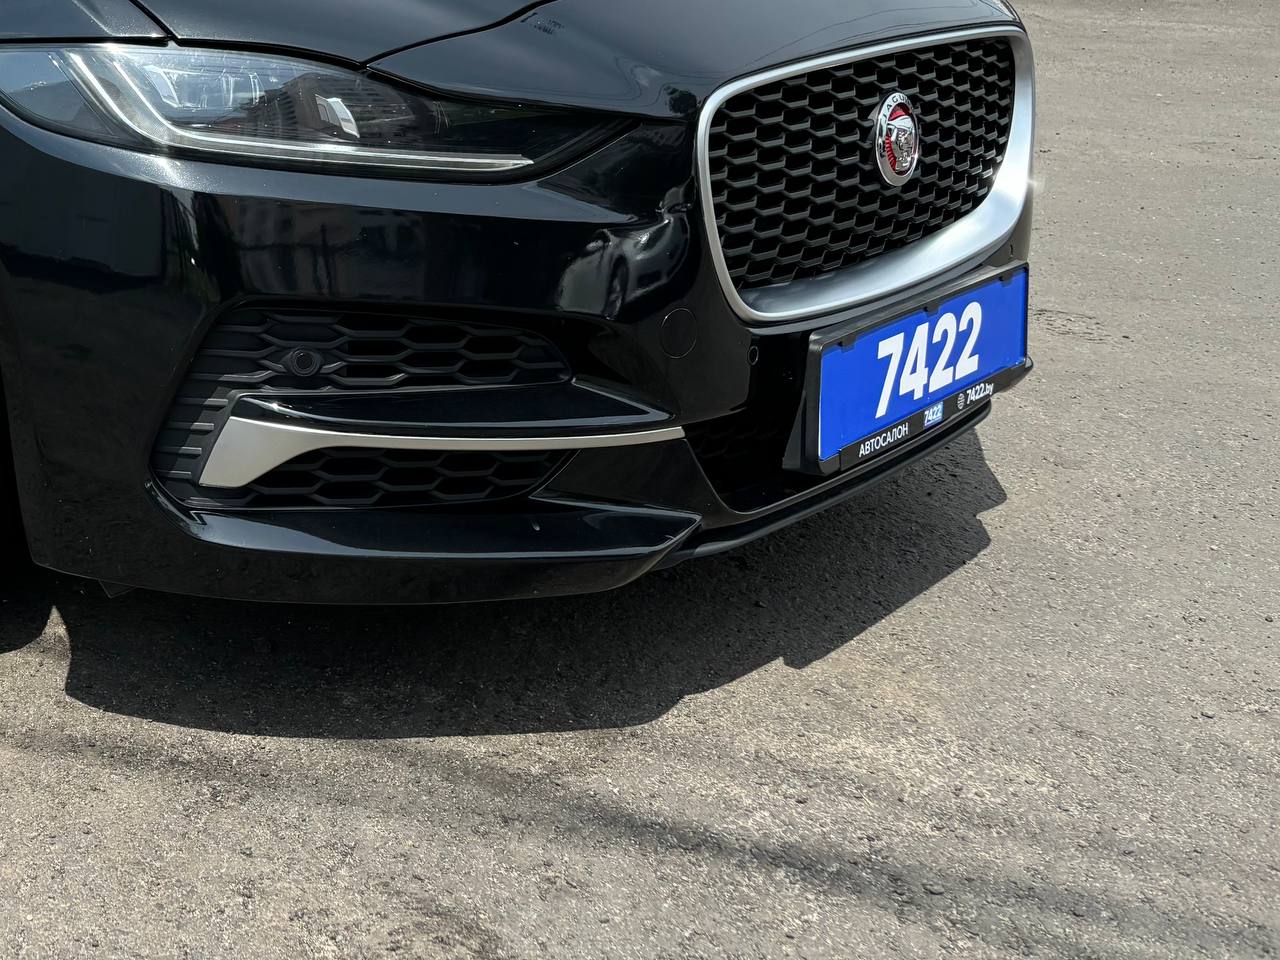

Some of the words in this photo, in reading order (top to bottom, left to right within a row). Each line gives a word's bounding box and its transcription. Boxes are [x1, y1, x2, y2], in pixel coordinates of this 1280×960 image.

[875, 301, 982, 419] 7422
[858, 422, 909, 458] АВТОСАЛОН
[924, 404, 942, 424] 7422
[966, 383, 994, 405] 7422.by
